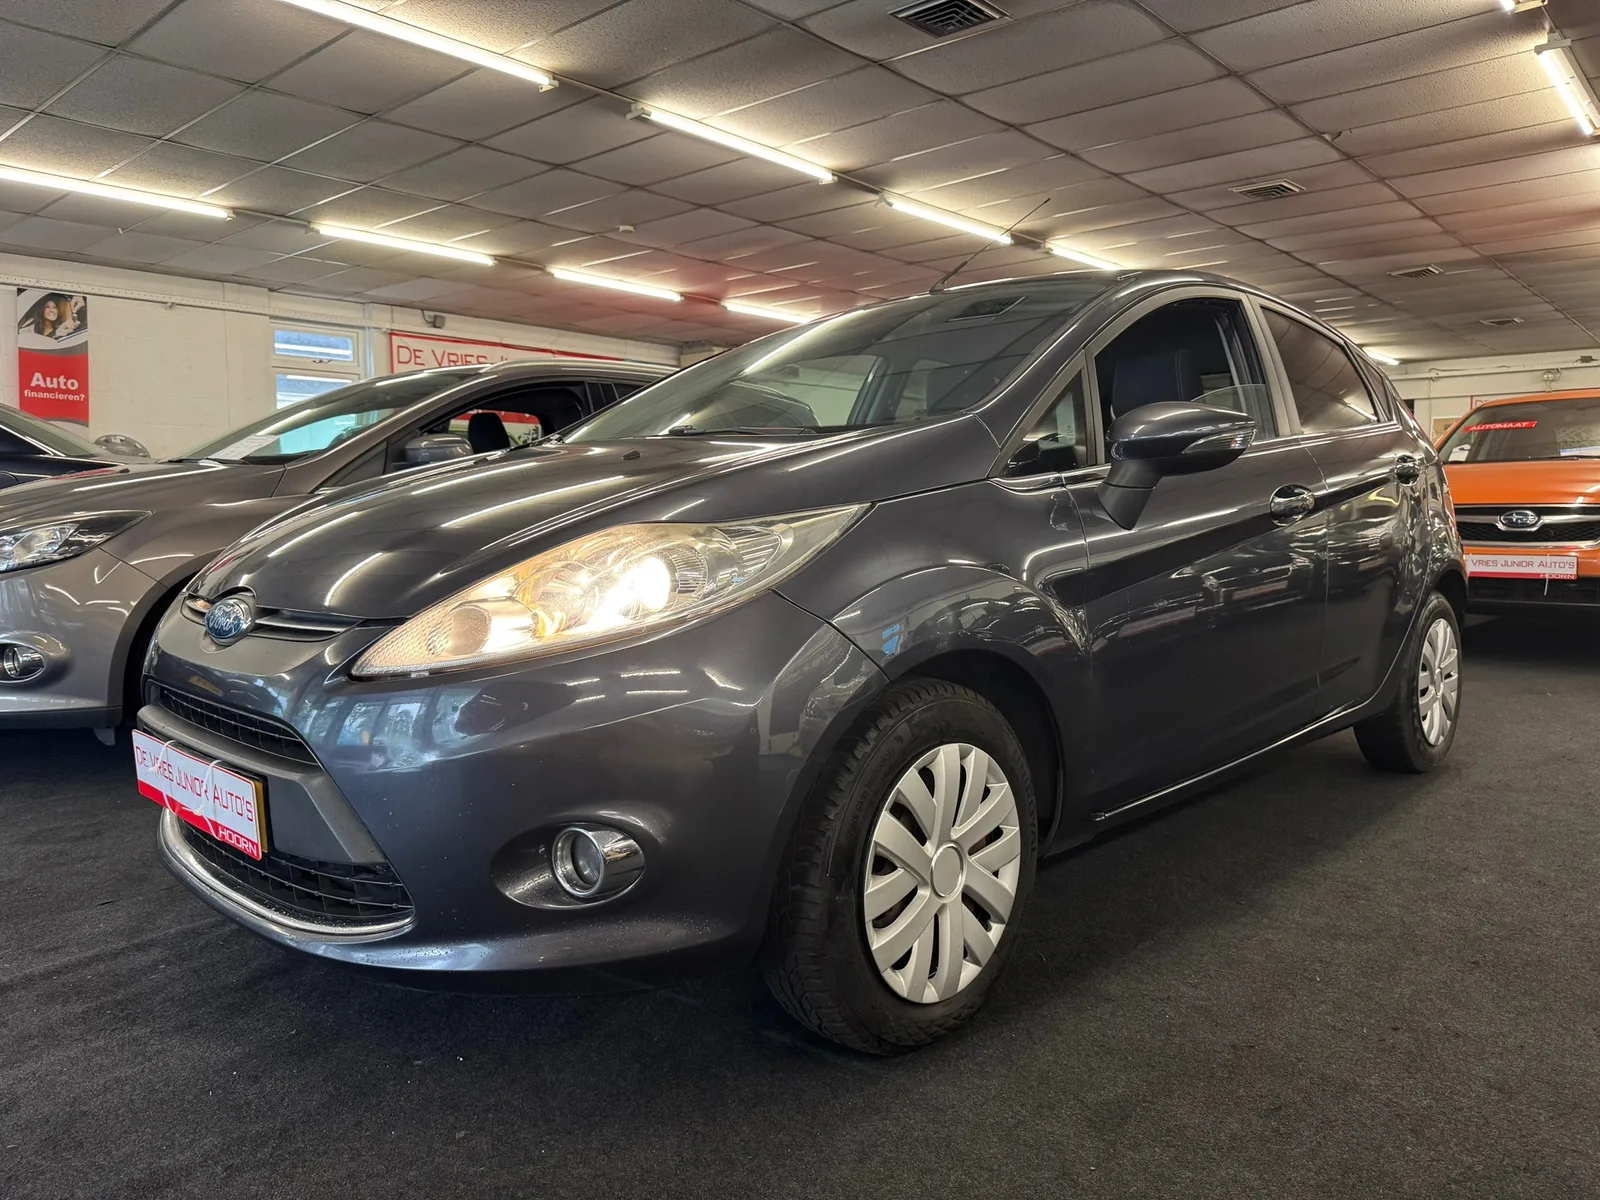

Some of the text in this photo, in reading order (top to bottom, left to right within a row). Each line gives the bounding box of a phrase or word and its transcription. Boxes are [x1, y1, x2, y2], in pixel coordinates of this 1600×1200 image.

[397, 345, 488, 368] DE VRIES
[30, 372, 79, 390] Auto
[24, 389, 85, 401] financieren?
[1469, 422, 1527, 431] AUTOMAAT
[1471, 559, 1575, 569] VRIES JUNIOR AUTO'S
[135, 745, 148, 768] DE
[213, 784, 254, 823] AUTO'S
[856, 790, 869, 811] Skin
[218, 825, 258, 857] HOORN
